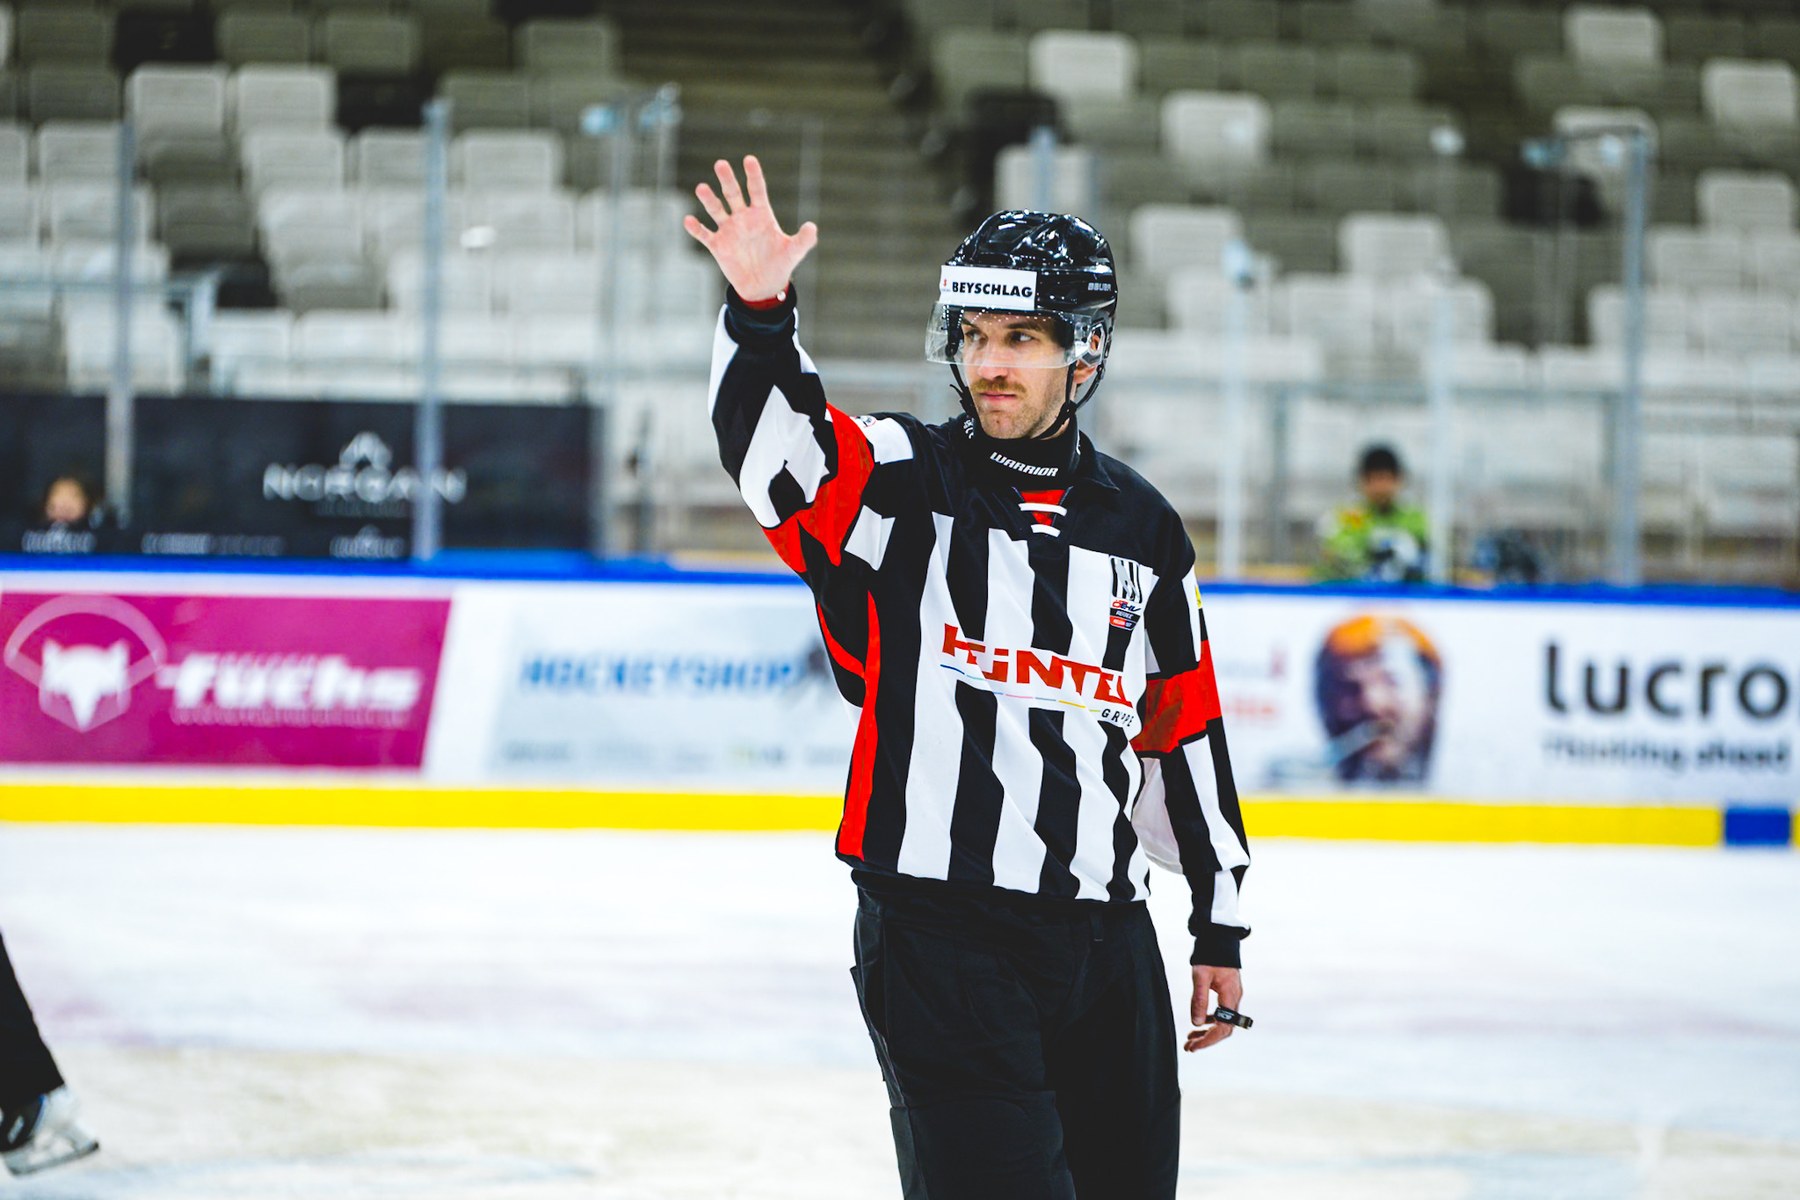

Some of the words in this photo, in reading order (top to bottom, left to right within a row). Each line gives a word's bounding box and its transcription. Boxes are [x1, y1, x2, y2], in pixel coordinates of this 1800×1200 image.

[952, 281, 1033, 298] BEYSCHLAG
[989, 451, 1059, 477] WARRIOR
[522, 652, 794, 690] HOCKEYSHOP
[1546, 643, 1790, 720] lucro
